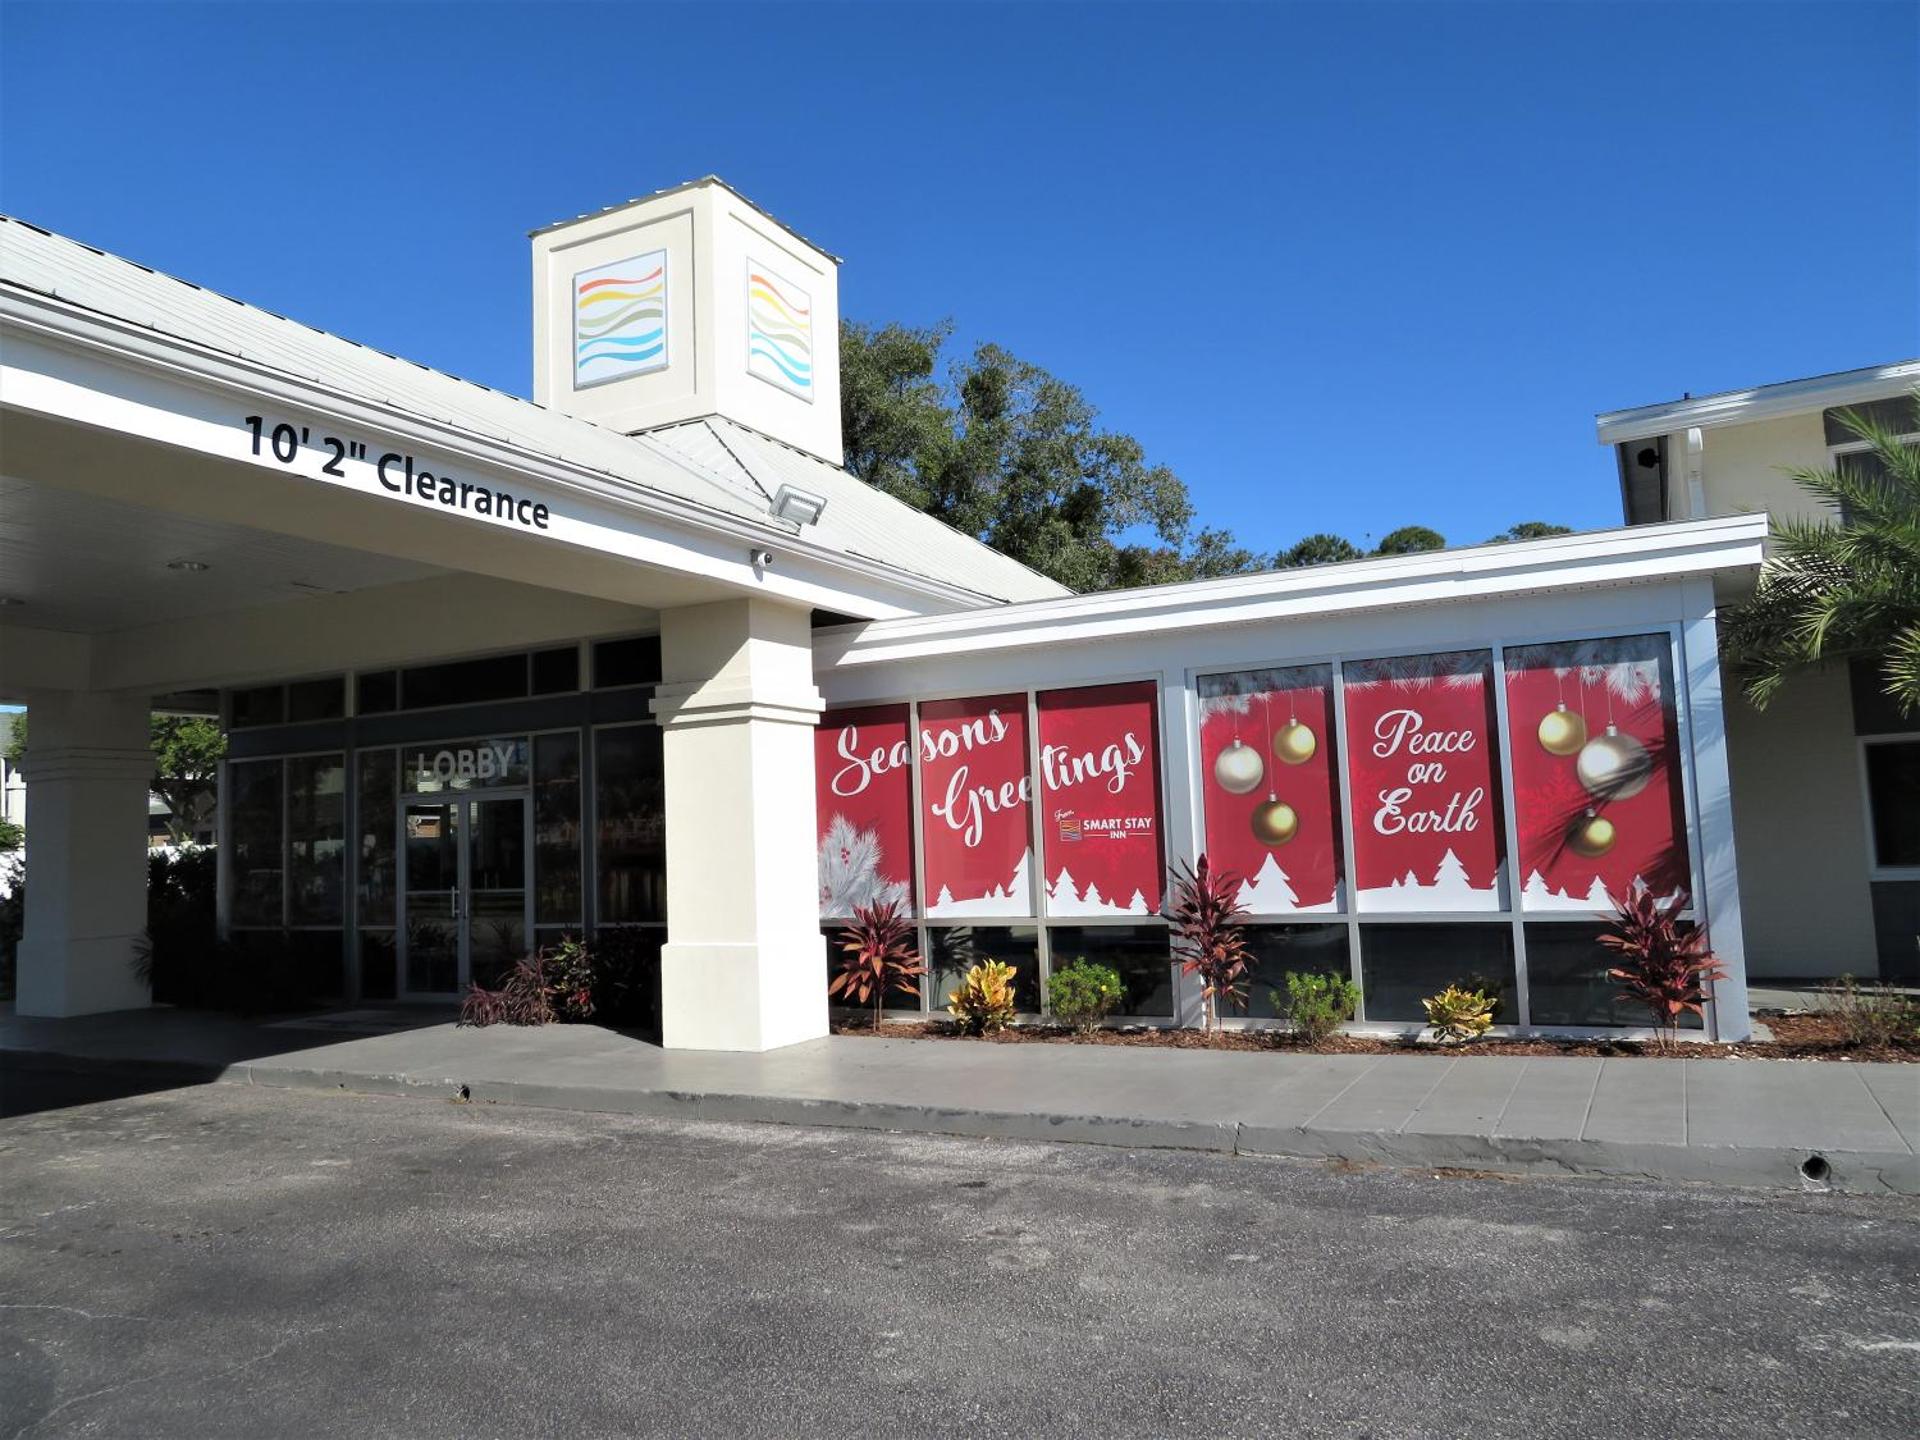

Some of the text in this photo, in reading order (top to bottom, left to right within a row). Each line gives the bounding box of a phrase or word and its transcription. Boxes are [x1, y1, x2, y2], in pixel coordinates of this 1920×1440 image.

[245, 415, 549, 529] 10' 2" Clearance
[831, 709, 1008, 796] Seasons
[1373, 709, 1477, 758] Peace
[417, 744, 515, 783] LOBBY
[1407, 762, 1447, 784] on
[931, 732, 1145, 847] Greetings
[1373, 787, 1484, 835] Earth
[1083, 817, 1153, 831] SMART STAY
[1110, 830, 1127, 839] INN
